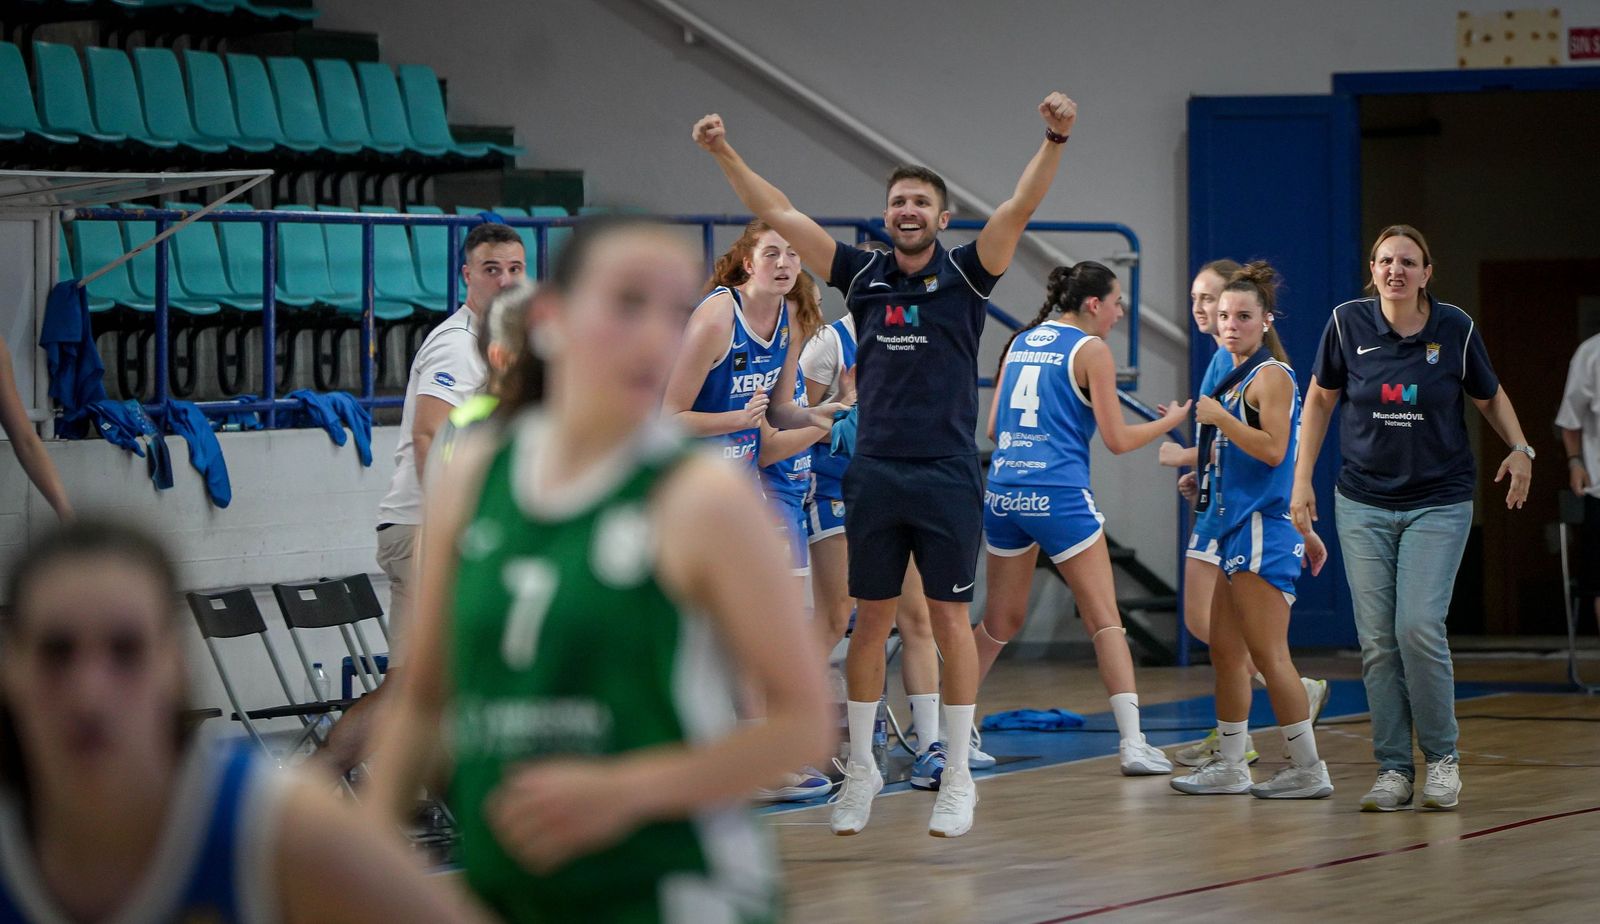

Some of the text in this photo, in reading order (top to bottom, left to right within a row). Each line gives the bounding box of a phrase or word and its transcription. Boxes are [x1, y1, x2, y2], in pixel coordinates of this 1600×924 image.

[876, 334, 928, 344] MundoMÓVIL
[731, 366, 782, 395] XEREZ
[1010, 365, 1041, 428] 4
[1372, 411, 1425, 421] MundoMÓVIL
[1384, 420, 1412, 428] Network
